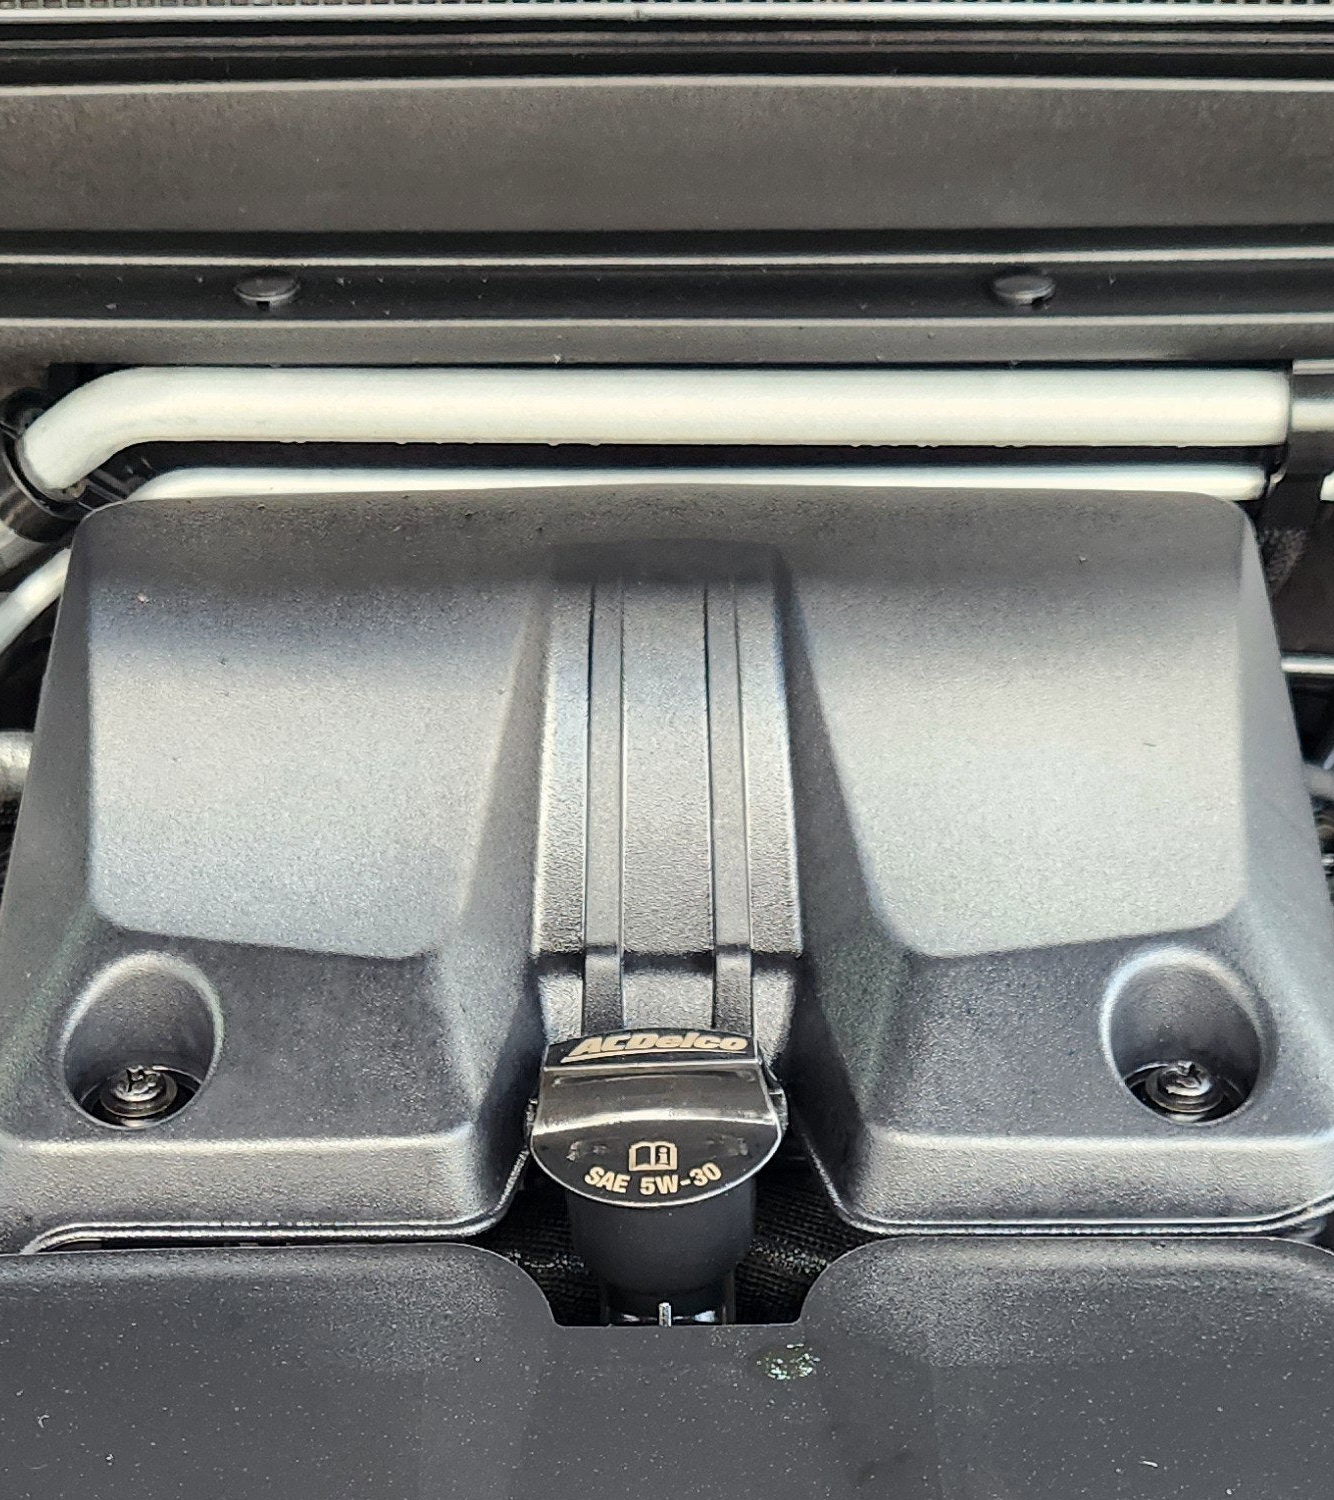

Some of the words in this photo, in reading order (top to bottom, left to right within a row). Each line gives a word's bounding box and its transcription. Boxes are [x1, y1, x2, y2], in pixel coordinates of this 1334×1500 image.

[567, 1032, 749, 1057] ACDelco
[584, 1166, 631, 1193] SAE
[639, 1162, 722, 1196] 5W-30
